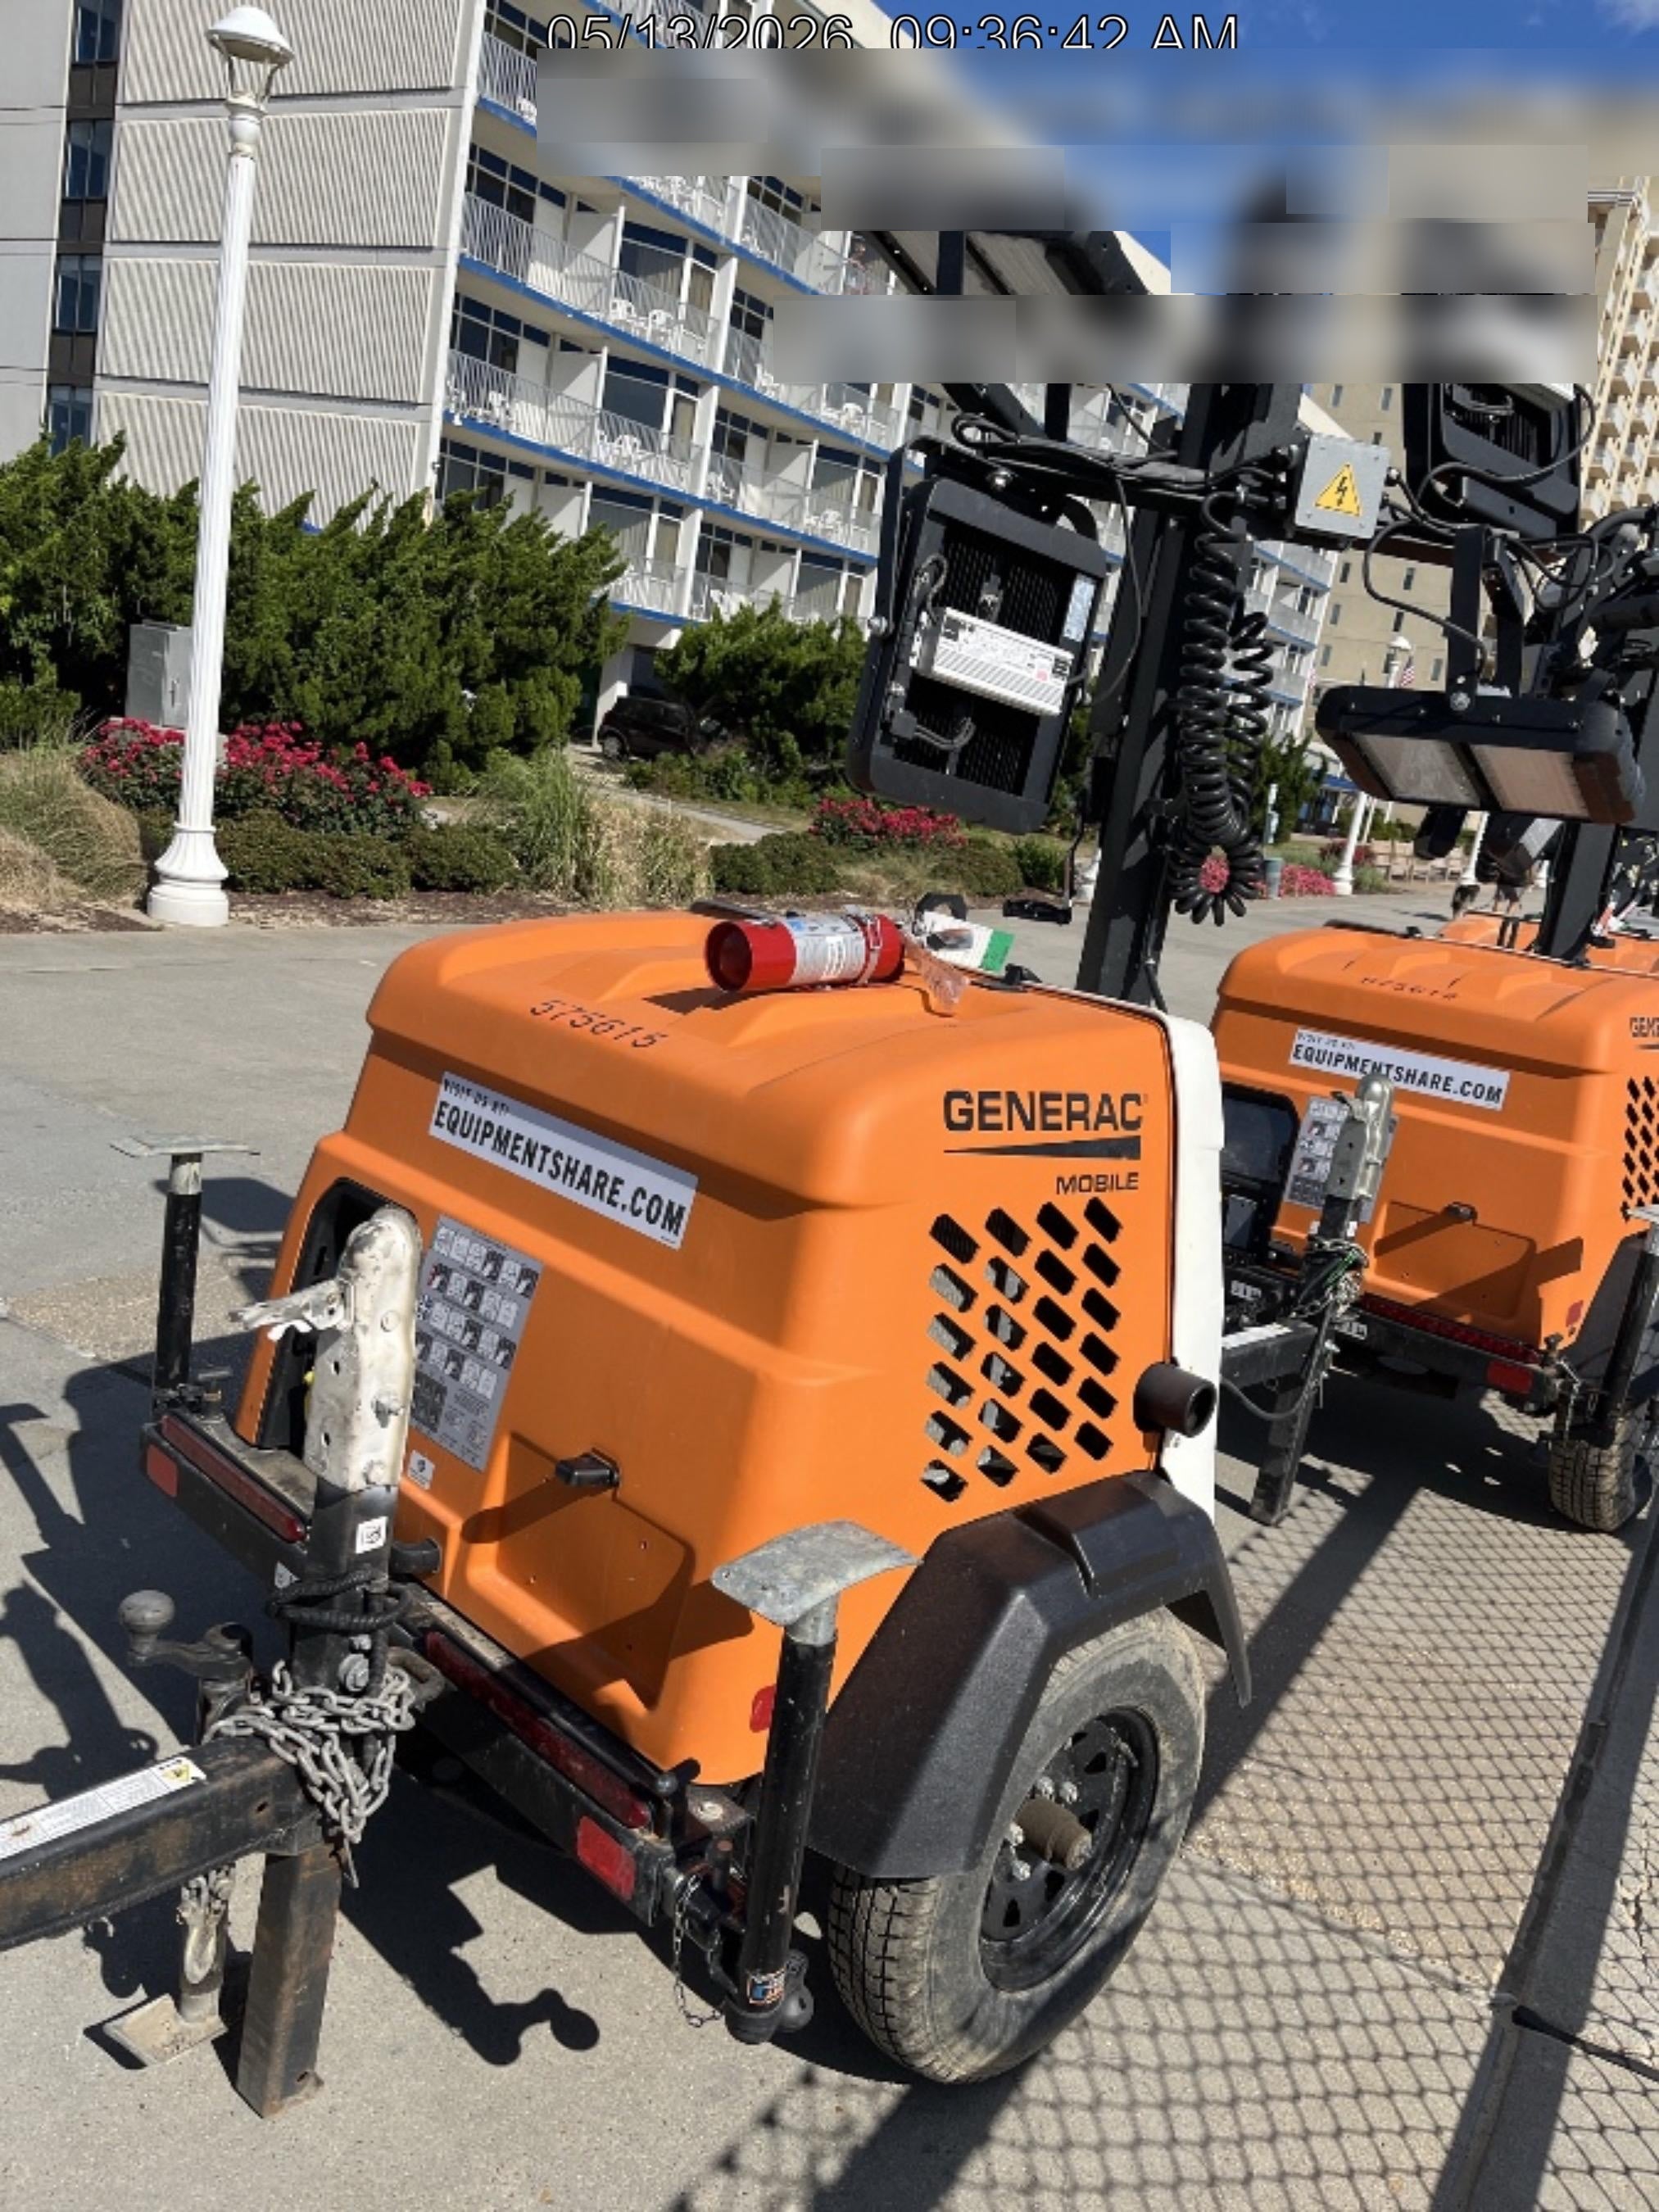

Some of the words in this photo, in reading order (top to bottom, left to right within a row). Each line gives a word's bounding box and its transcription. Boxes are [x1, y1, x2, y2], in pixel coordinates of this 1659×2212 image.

[943, 1090, 1143, 1131] GENERAC
[433, 1100, 687, 1237] EQUIPMENTSHARE.COM
[1056, 1172, 1140, 1194] MOBILE
